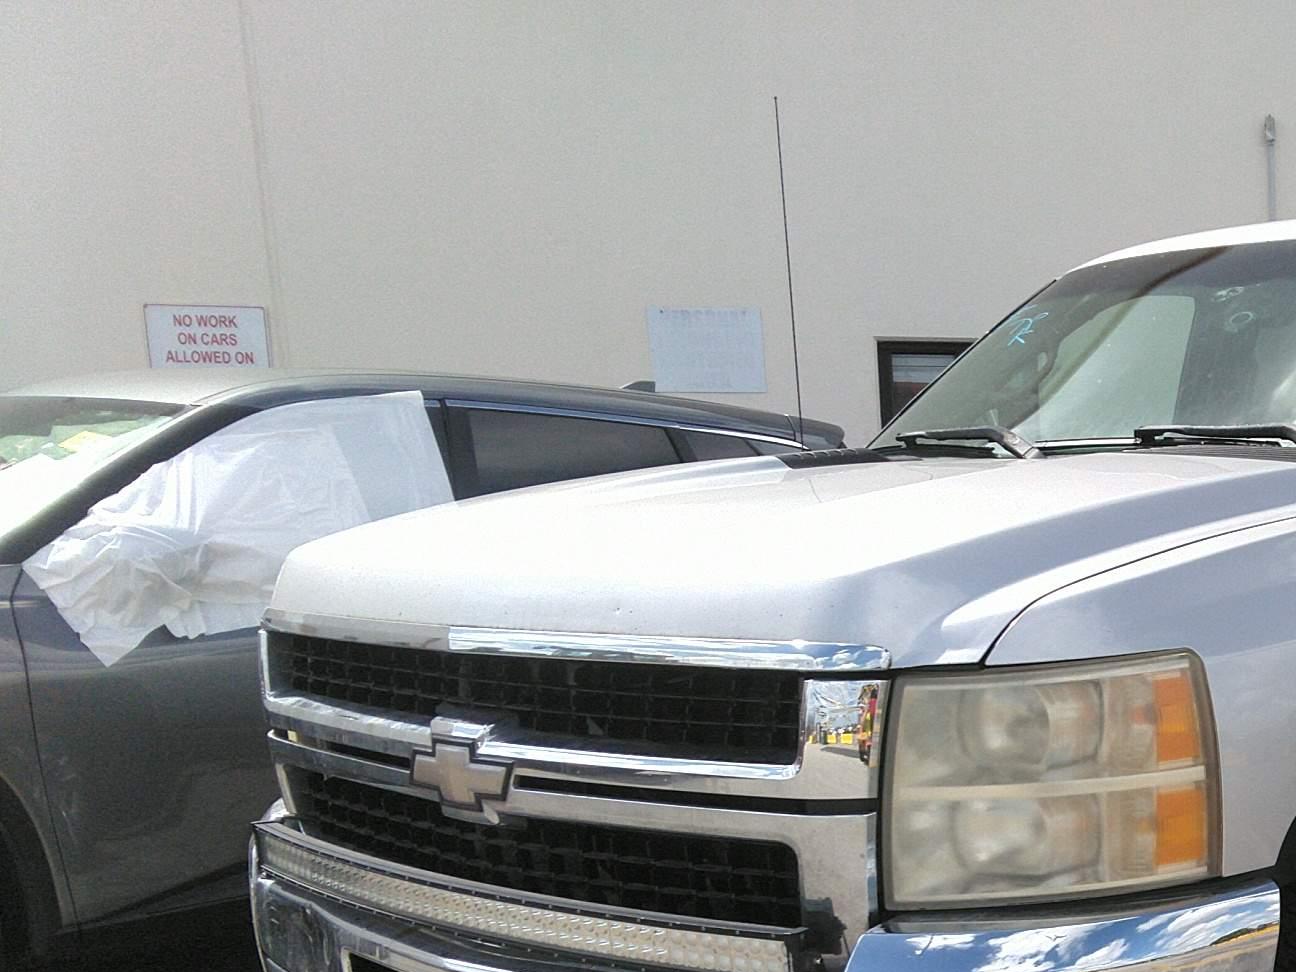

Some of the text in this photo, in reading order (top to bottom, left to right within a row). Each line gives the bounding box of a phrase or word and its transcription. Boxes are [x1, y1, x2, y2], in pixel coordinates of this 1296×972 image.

[172, 314, 238, 328] NO WORK
[177, 332, 238, 346] ON CARS
[165, 350, 255, 364] ALLOWED ON
